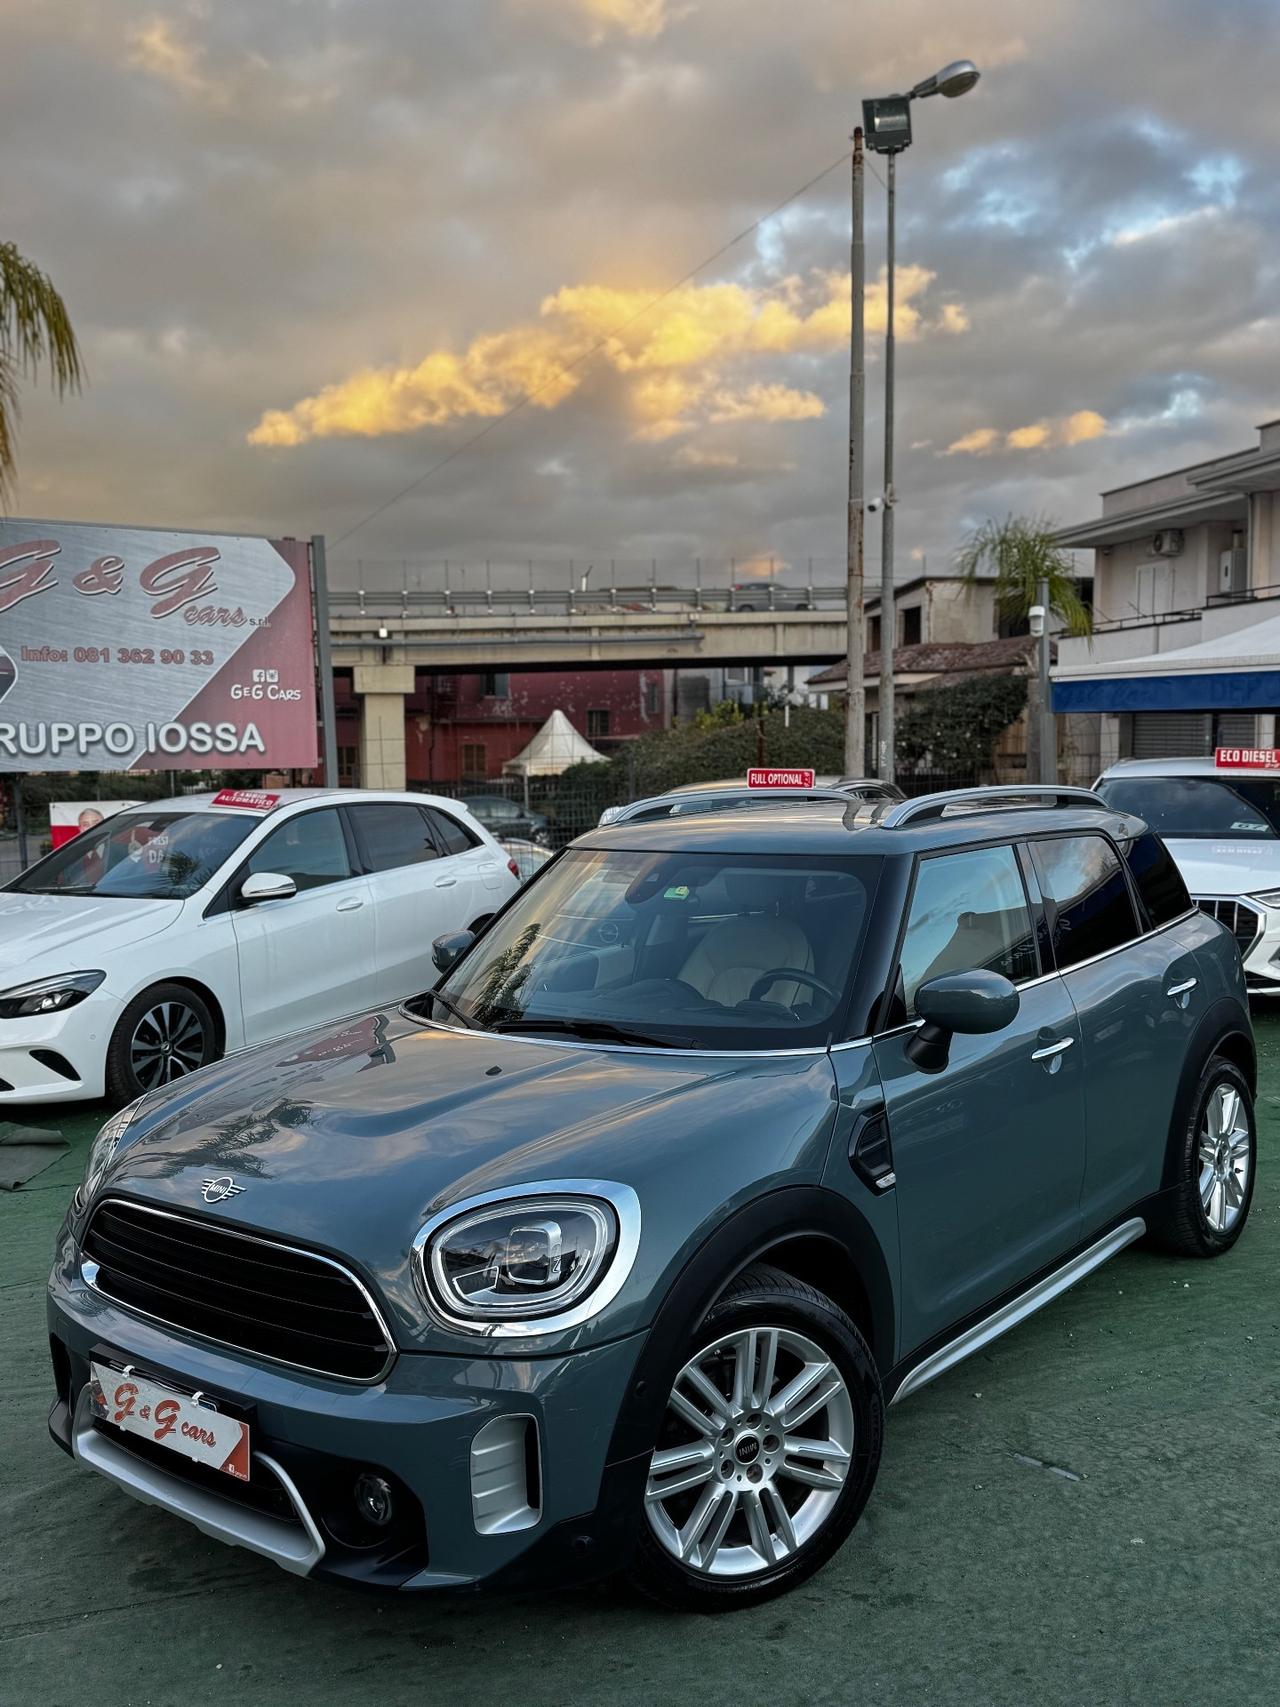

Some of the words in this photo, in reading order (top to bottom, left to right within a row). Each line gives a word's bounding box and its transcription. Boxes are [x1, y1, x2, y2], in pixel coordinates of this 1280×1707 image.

[72, 555, 124, 595] &
[139, 546, 221, 619] G
[184, 605, 247, 628] cars
[21, 645, 68, 662] Info:
[73, 646, 110, 663] 081
[118, 648, 155, 664] 362
[160, 649, 185, 665] 90
[190, 650, 214, 665] 33
[147, 722, 265, 754] IOSSA
[1220, 750, 1240, 762] ECO
[1242, 750, 1278, 763] DIESEL
[750, 773, 767, 785] FULL
[767, 773, 803, 785] OPTIONAL
[218, 794, 274, 806] AUTOMATICO
[208, 1184, 227, 1193] MINI
[114, 1382, 139, 1423] G
[139, 1405, 150, 1421] &
[154, 1399, 181, 1440] G
[181, 1421, 216, 1448] cars
